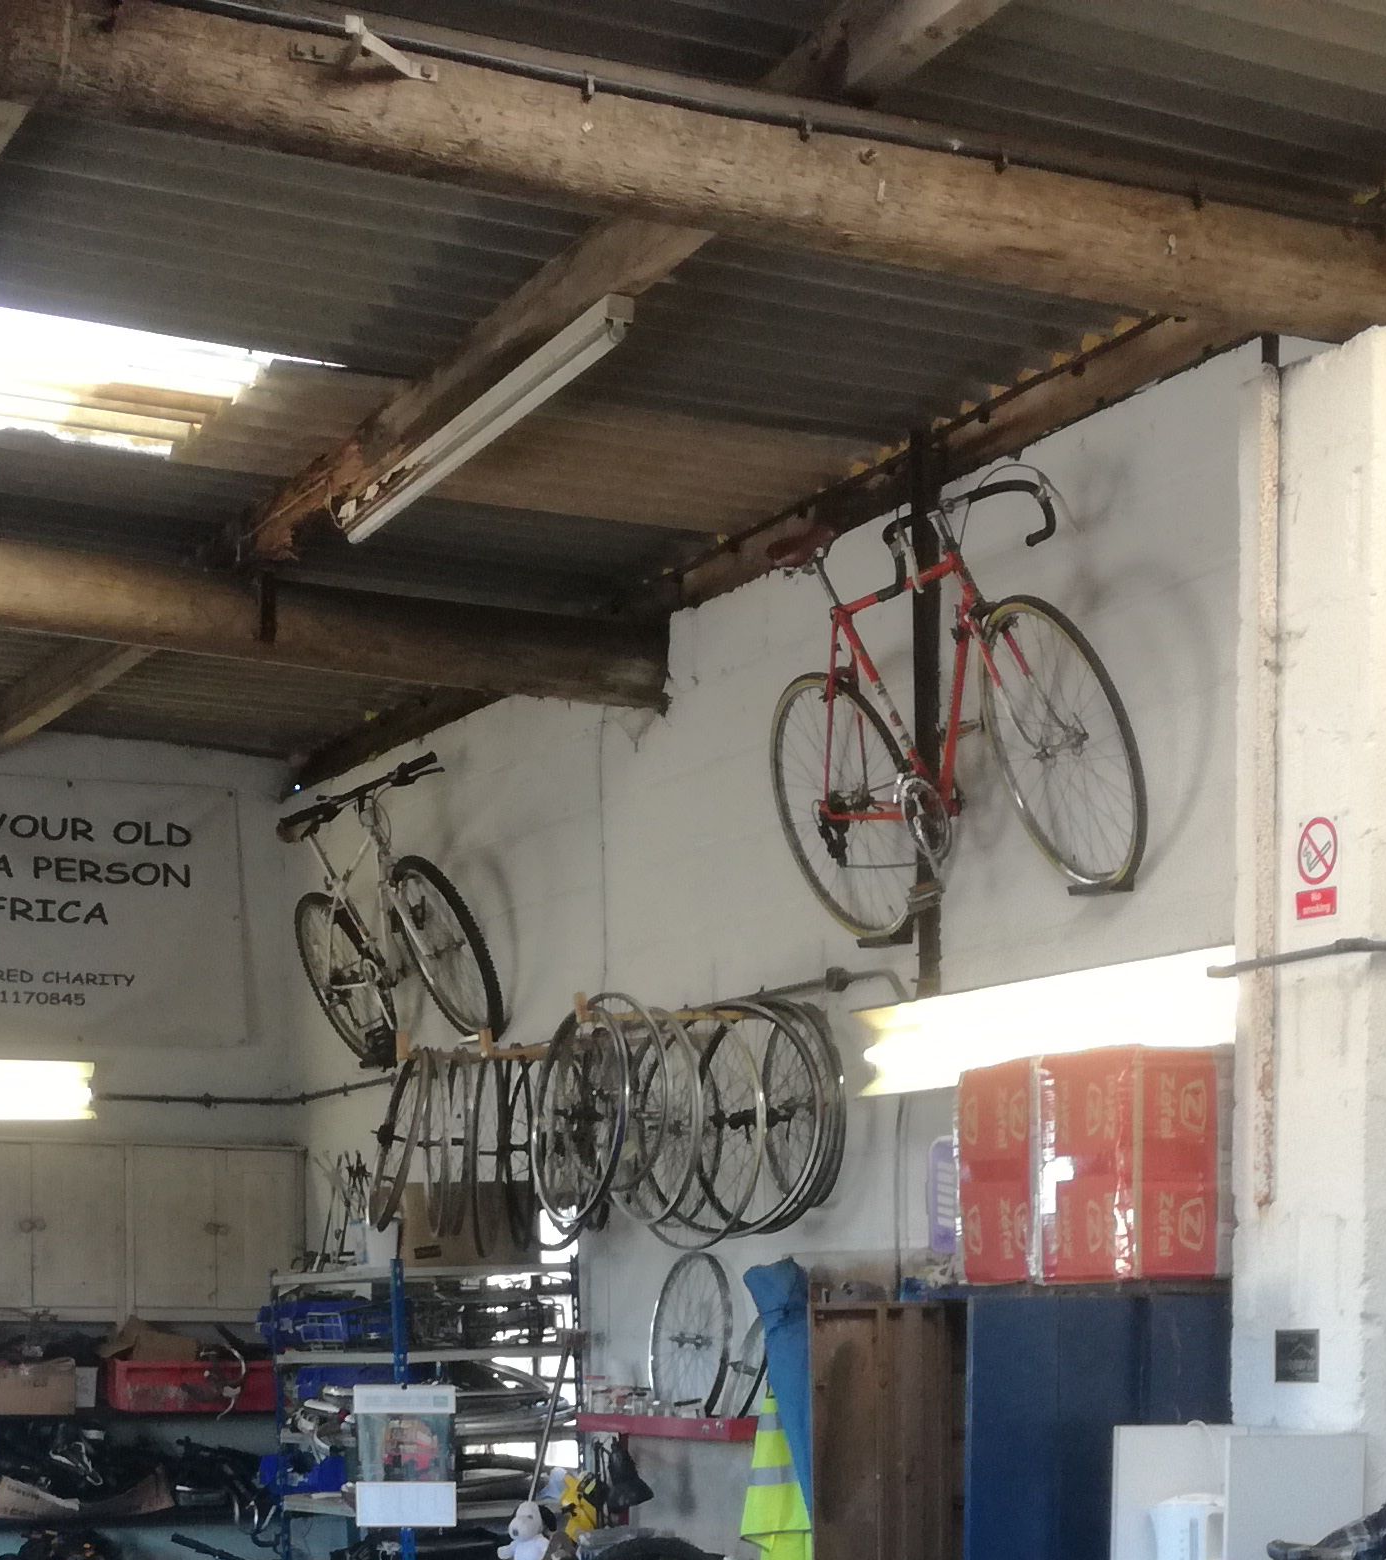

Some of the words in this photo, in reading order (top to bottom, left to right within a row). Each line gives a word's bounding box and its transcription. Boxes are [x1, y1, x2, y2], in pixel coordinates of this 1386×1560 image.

[113, 820, 192, 847] OLD
[33, 855, 192, 888] PERSON
[42, 971, 135, 987] CHARITY
[0, 990, 86, 1007] 1170845
